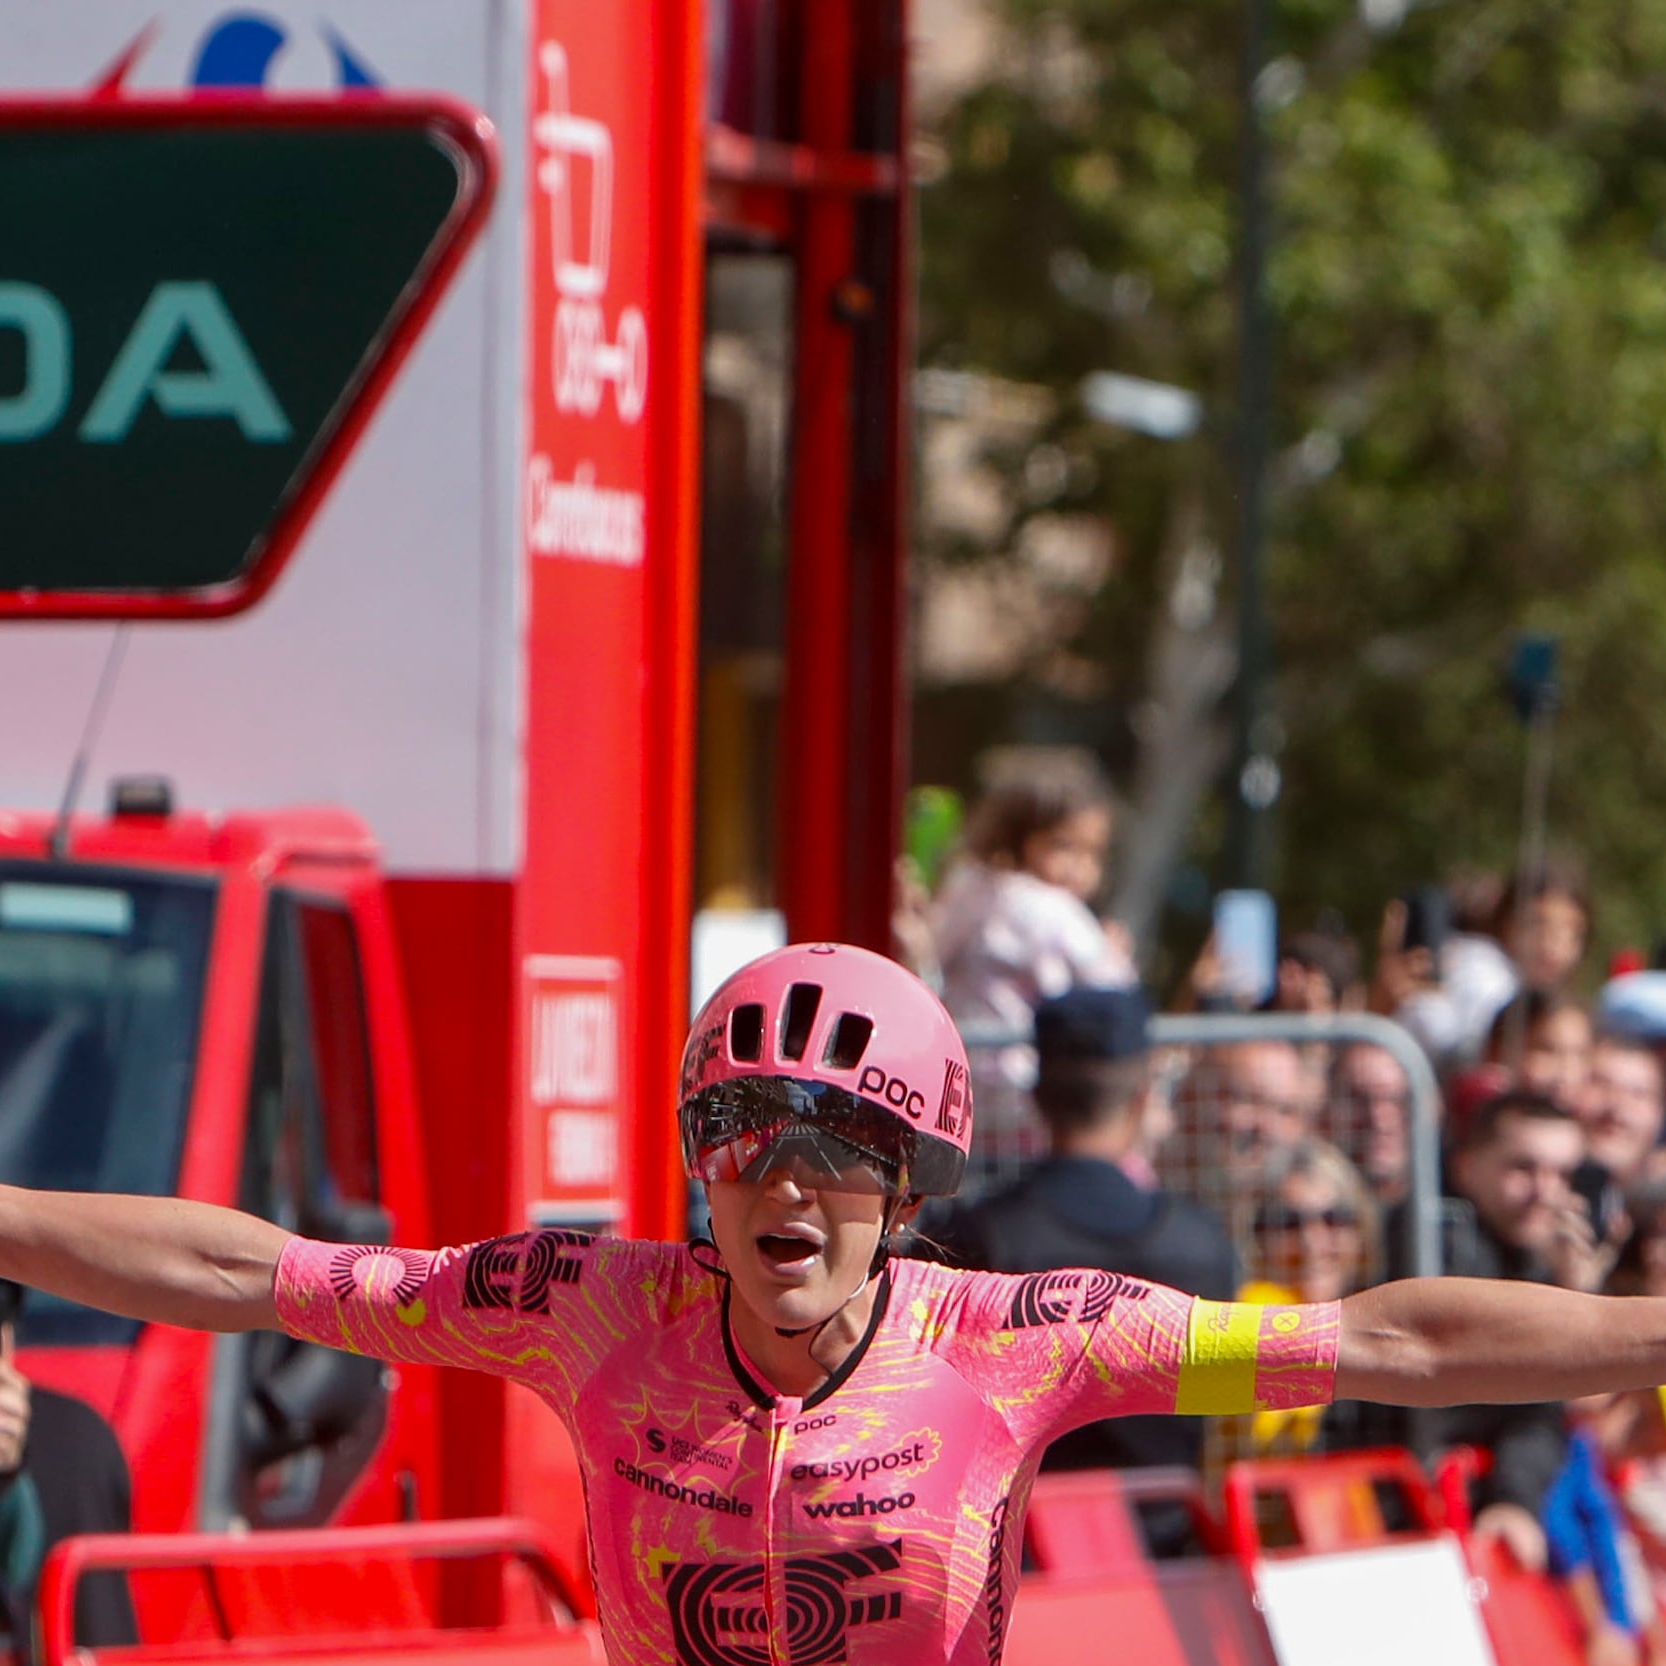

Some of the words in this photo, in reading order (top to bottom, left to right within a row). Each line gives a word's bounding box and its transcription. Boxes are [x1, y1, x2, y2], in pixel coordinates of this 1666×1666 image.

[790, 1443, 924, 1482] easypost
[614, 1457, 753, 1518] cannondale
[803, 1492, 916, 1519] wahoo
